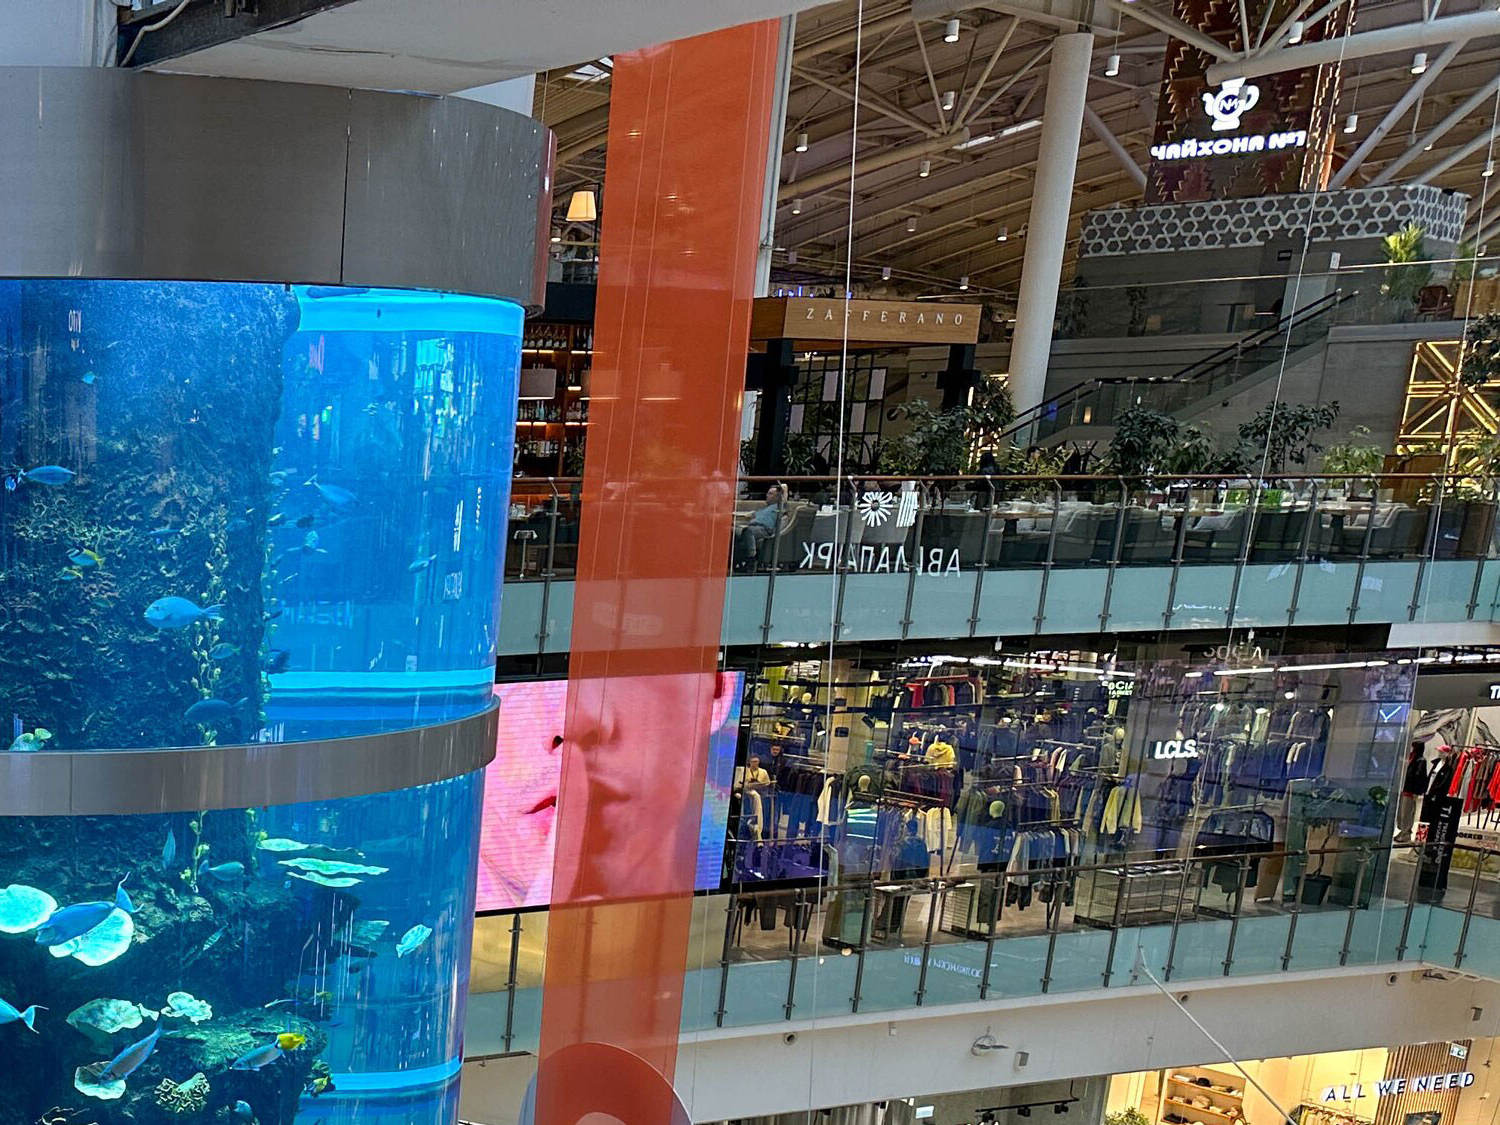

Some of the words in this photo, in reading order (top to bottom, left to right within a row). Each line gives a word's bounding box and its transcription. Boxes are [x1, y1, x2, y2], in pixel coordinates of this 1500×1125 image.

[1151, 135, 1265, 160] ЧАЙХОНА
[806, 306, 964, 327] ZAFFERANO
[1323, 1085, 1366, 1102] ALL
[1377, 1079, 1407, 1097] WE
[1415, 1072, 1476, 1093] NEED
